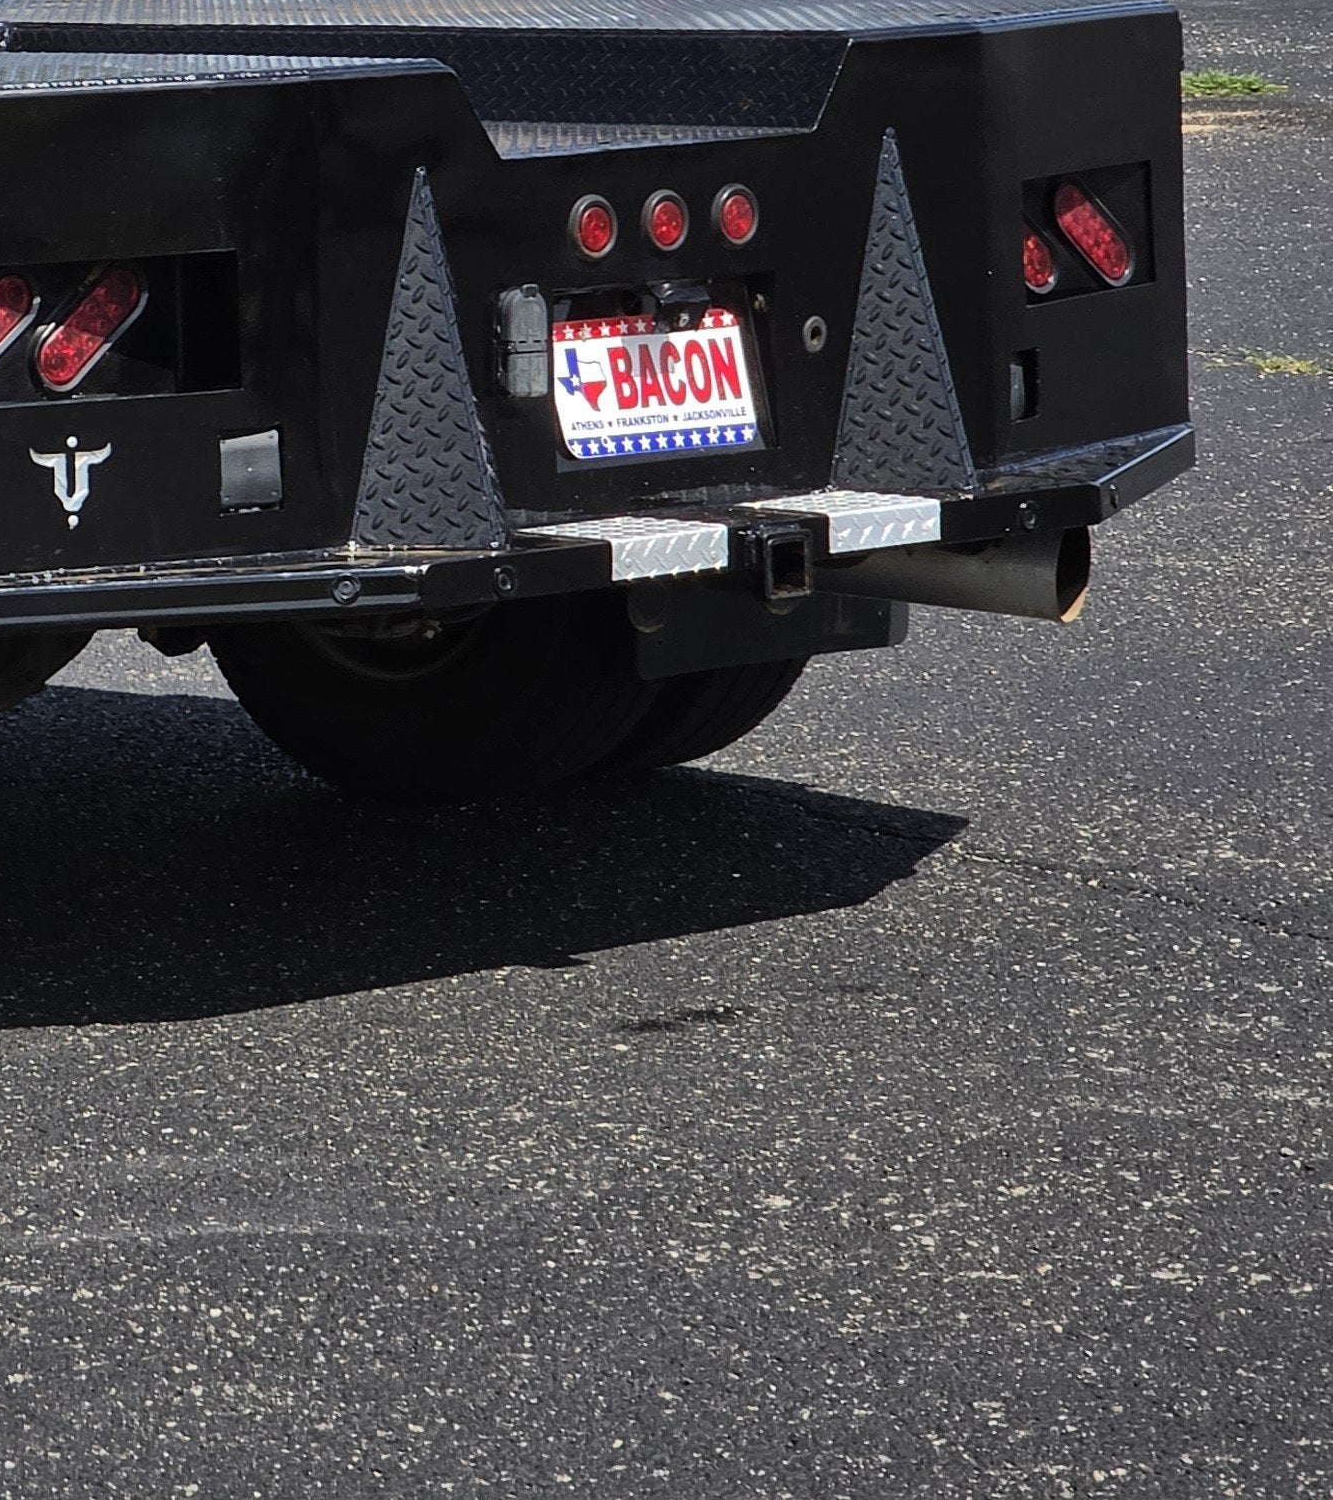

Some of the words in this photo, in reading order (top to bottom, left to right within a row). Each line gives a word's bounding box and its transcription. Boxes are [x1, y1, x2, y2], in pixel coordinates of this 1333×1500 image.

[606, 337, 743, 410] BACON
[571, 420, 605, 431] ATHENS
[616, 414, 670, 428] FRANKSTON
[682, 407, 747, 422] JACKSONVILLE
